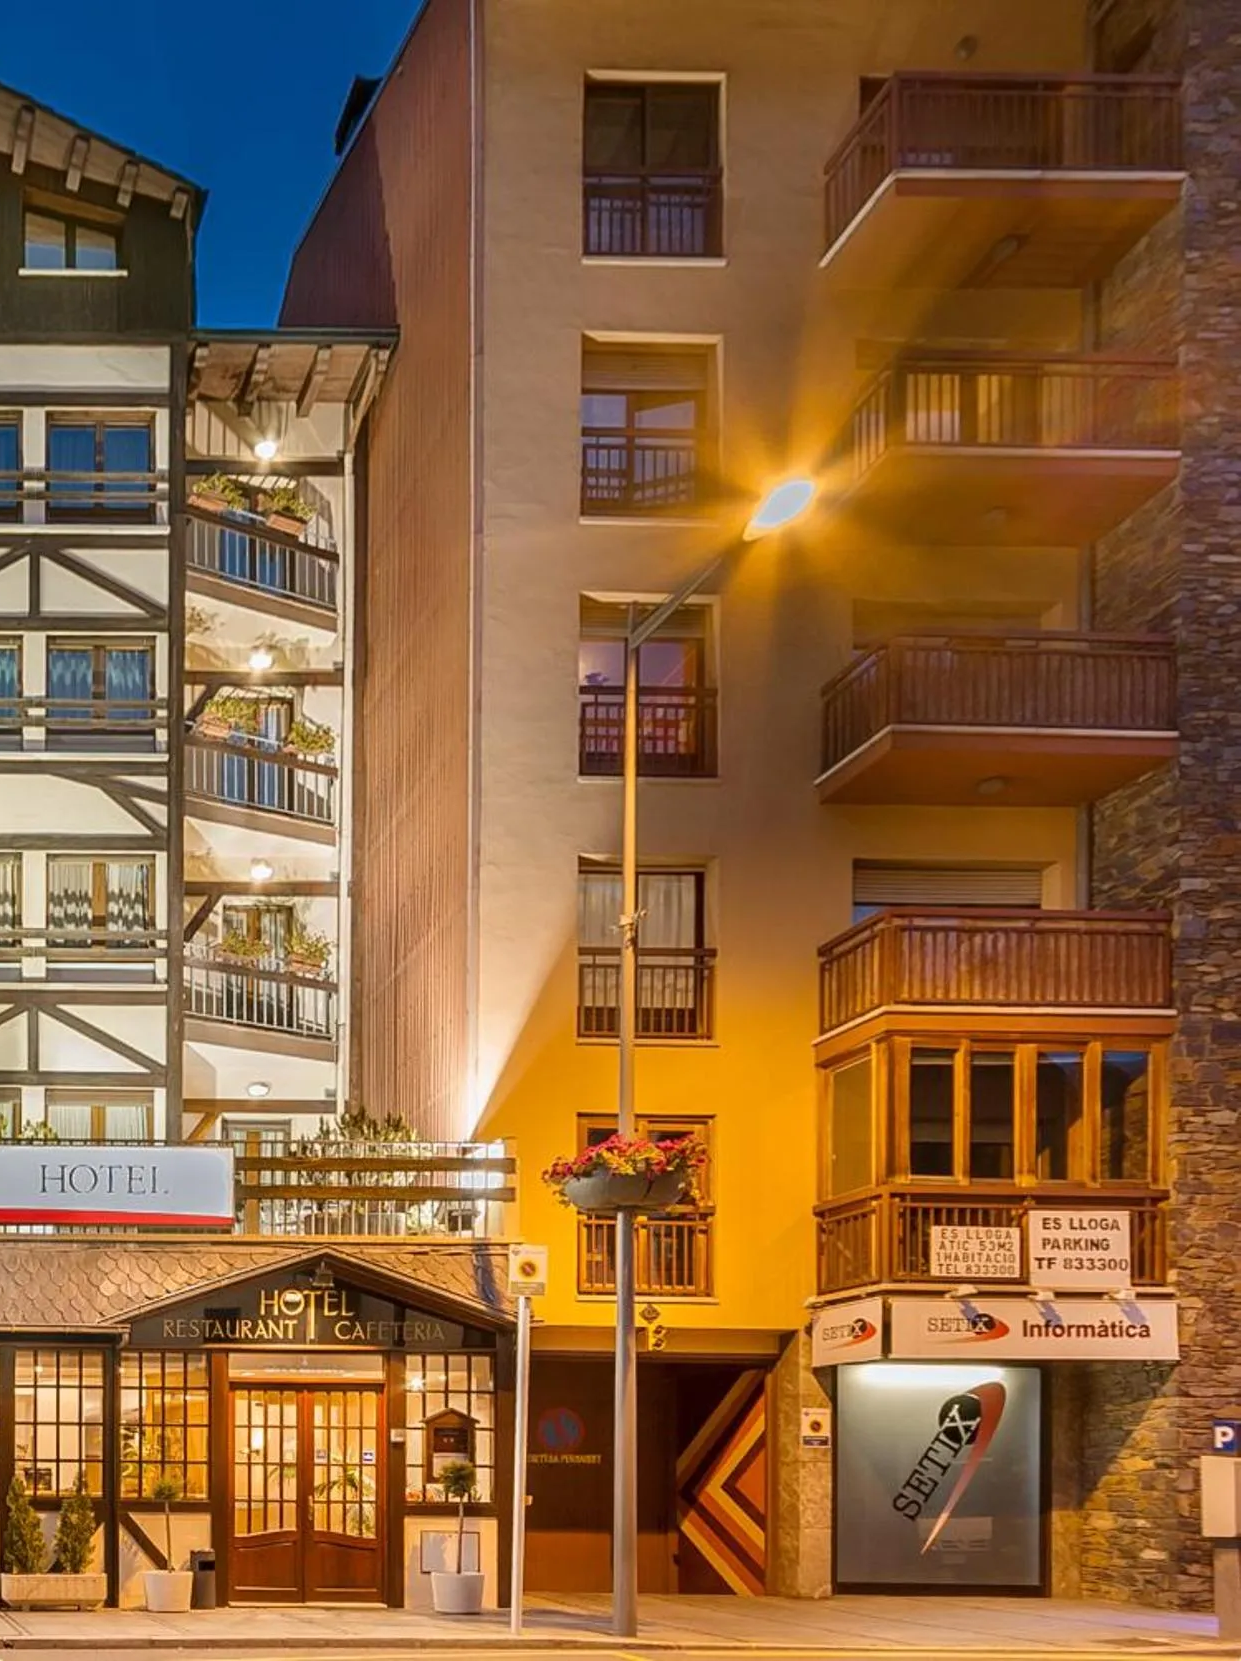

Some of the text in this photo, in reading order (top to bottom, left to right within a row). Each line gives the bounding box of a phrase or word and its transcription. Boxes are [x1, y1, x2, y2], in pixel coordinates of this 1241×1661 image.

[38, 1163, 170, 1196] HOTEL
[1042, 1217, 1121, 1231] ES LLOGA
[941, 1228, 1013, 1240] ES LLOGA
[939, 1240, 1014, 1252] ATIC 53M2
[1041, 1238, 1111, 1251] PARKING
[938, 1263, 1016, 1275] TEL 833300
[1033, 1257, 1129, 1271] TF 833300
[260, 1288, 356, 1340] HOTEL
[163, 1319, 445, 1341] RESTAURANT CAFETERIA
[1022, 1319, 1152, 1338] Informàtica
[1214, 1426, 1235, 1449] P
[892, 1403, 982, 1522] SETIX
